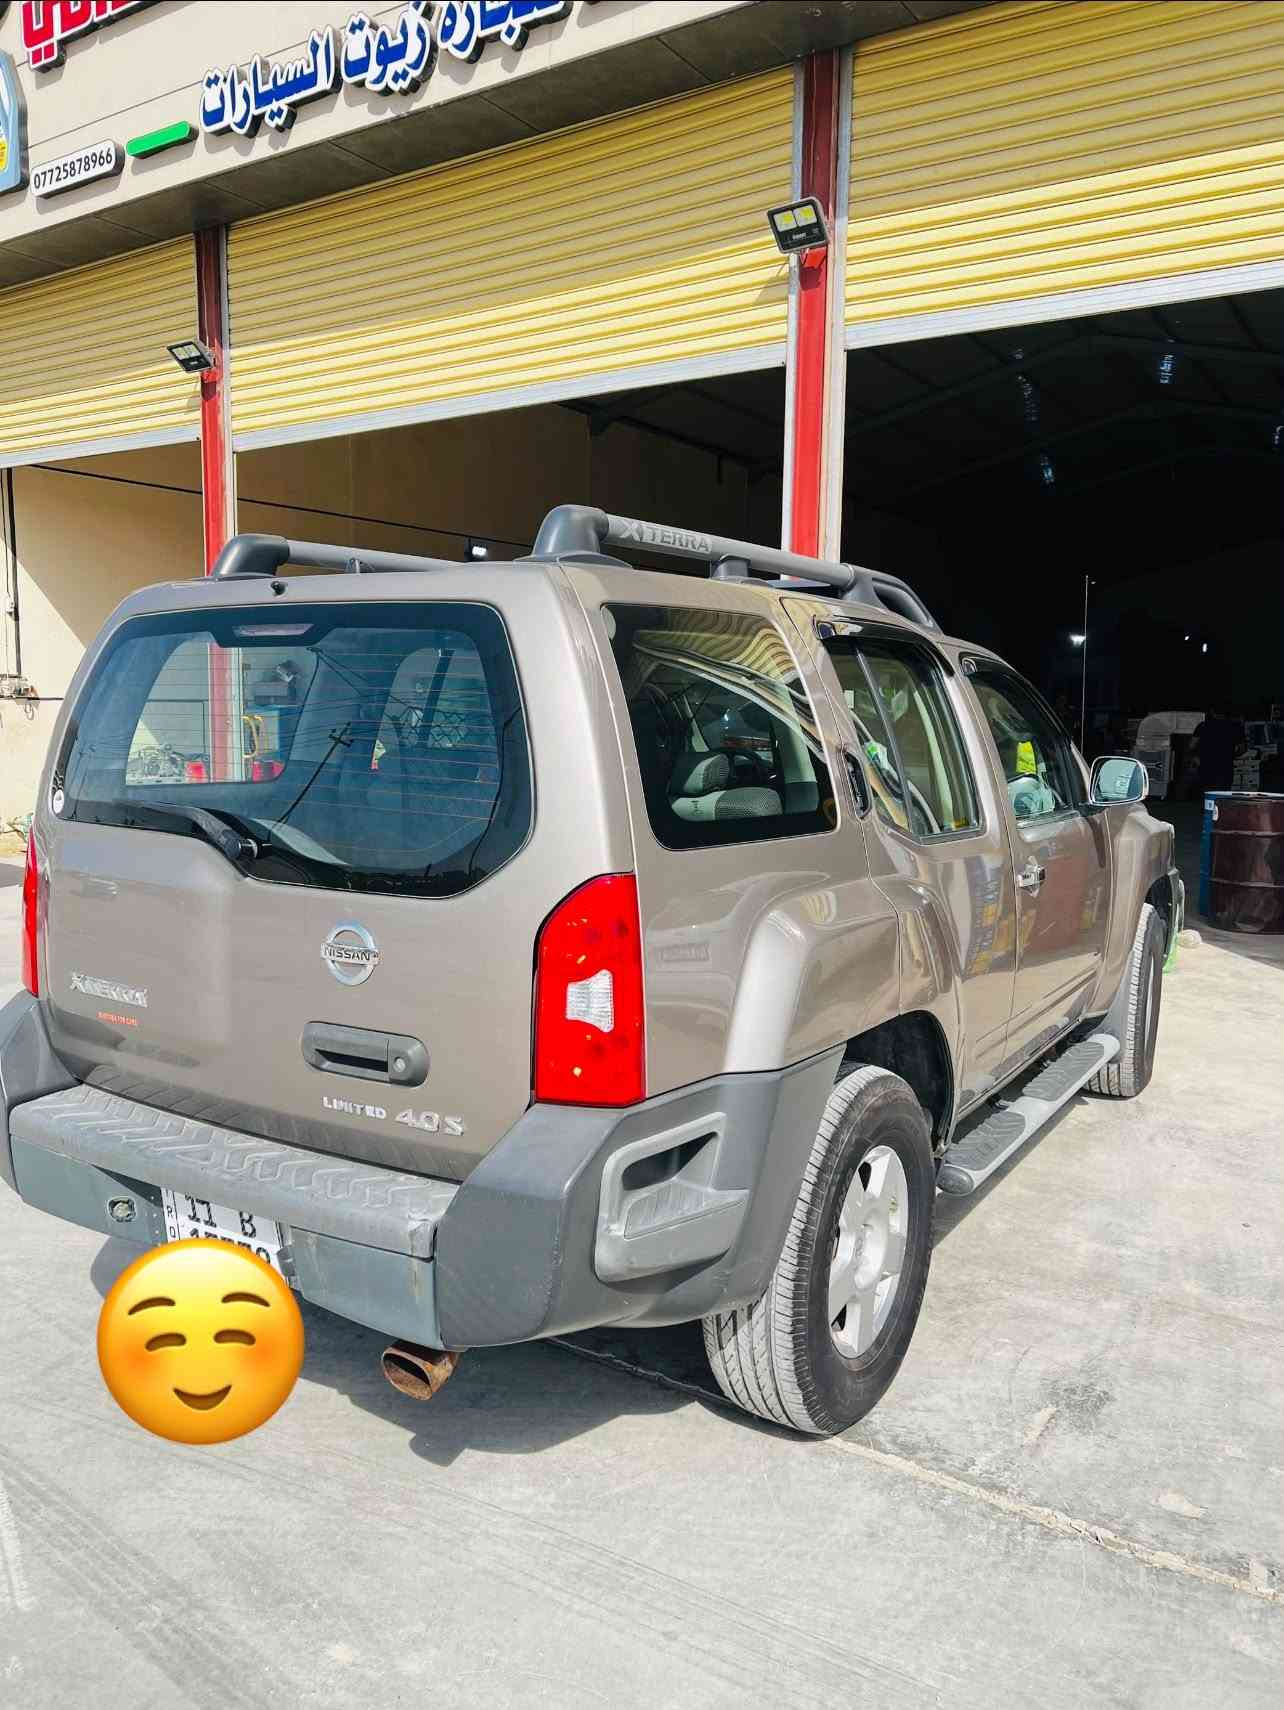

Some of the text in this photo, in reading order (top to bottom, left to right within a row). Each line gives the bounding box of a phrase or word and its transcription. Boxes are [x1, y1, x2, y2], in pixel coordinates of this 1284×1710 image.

[200, 26, 337, 133] السيارات
[33, 147, 114, 189] 07725878966
[323, 944, 372, 961] NISSAN
[322, 1096, 388, 1120] LIMITED
